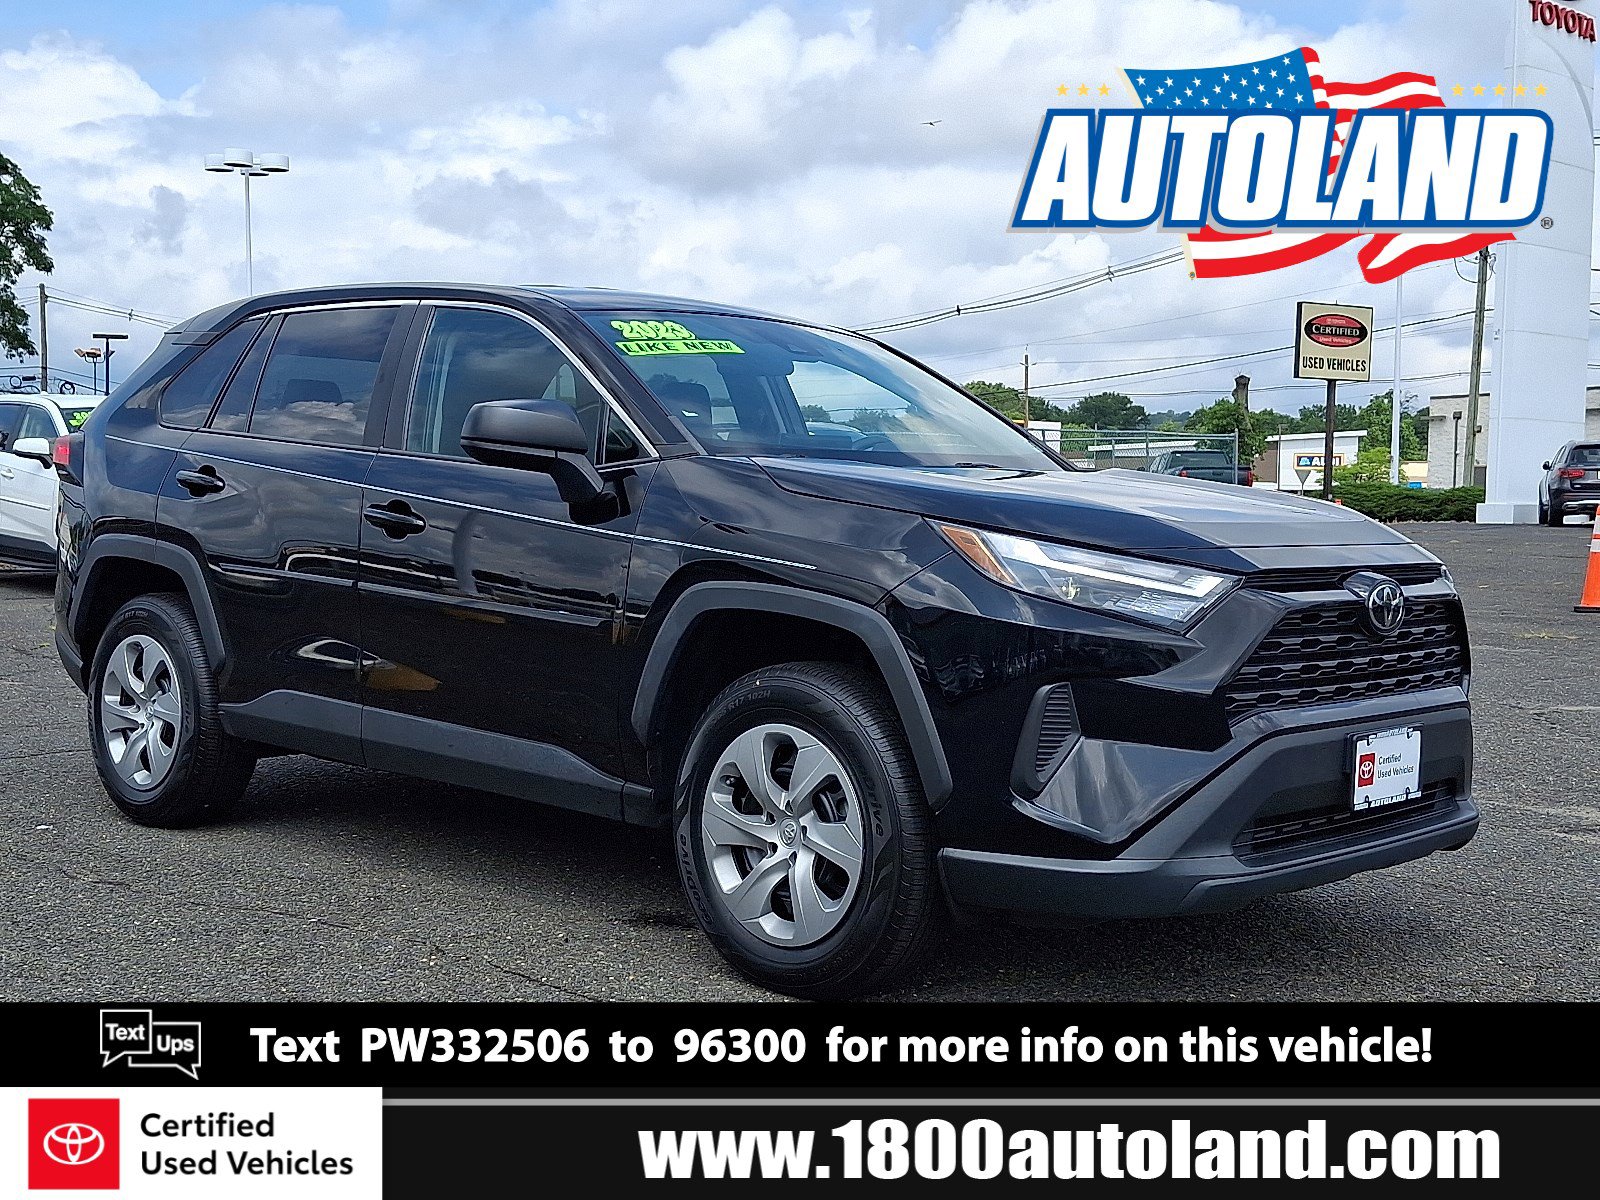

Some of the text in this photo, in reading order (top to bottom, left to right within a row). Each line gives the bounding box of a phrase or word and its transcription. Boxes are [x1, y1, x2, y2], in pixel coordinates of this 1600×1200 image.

[1529, 0, 1596, 43] TOYOTA
[1312, 324, 1360, 336] CERTIFIED
[623, 341, 730, 352] LIKE NEW
[1302, 356, 1367, 372] USED VEHICLES
[1378, 753, 1402, 765] Certified
[1377, 765, 1414, 779] Used Vehicles
